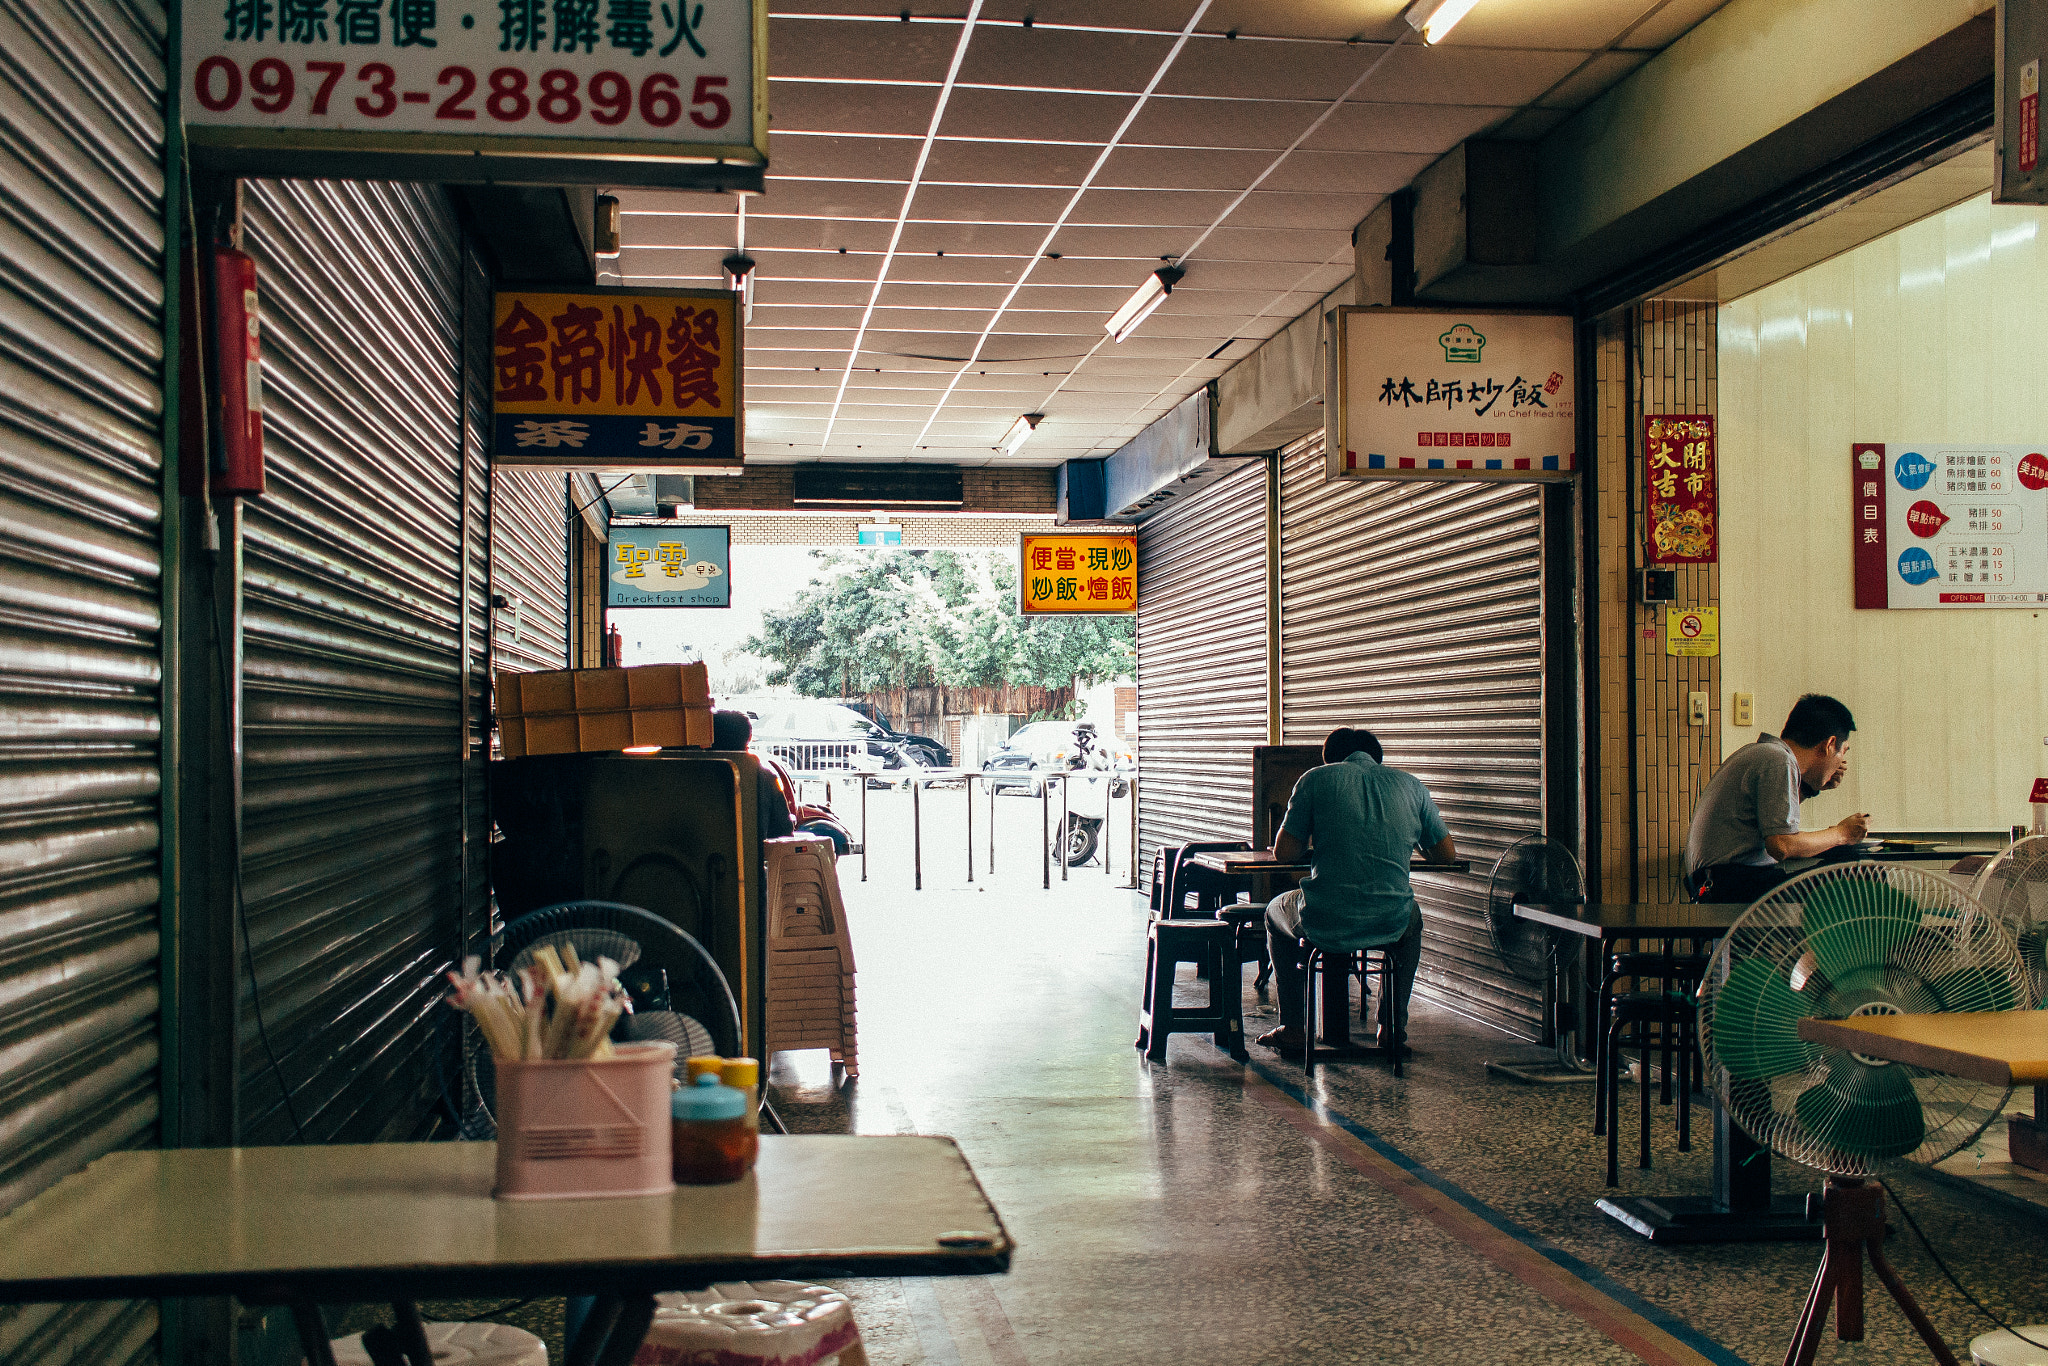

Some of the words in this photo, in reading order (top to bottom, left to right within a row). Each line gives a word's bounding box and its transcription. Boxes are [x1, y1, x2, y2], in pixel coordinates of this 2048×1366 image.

[194, 56, 732, 129] 0973-288965
[495, 300, 722, 409] 金帝快餐
[1379, 375, 1548, 417] 林師炒飯
[1493, 410, 1506, 418] Lin
[1508, 410, 1531, 418] Chef
[1533, 410, 1554, 418] fried
[1556, 410, 1573, 418] rice
[514, 420, 714, 450] 茶坊
[1419, 433, 1511, 446] 專業美式炒飯
[1946, 455, 1987, 466] 豬排燴飯
[1990, 456, 2001, 465] 60
[1652, 442, 1681, 498] 大吉
[1683, 441, 1707, 499] 開市
[1946, 468, 1987, 478] 魚排燴飯
[1990, 469, 2001, 478] 60
[1946, 481, 1987, 491] 豬肉燴飯
[1990, 482, 2001, 491] 60
[1863, 481, 1879, 544] 價目表
[1968, 508, 1988, 518] 豬排
[1991, 509, 2002, 518] 50
[1968, 521, 1988, 531] 魚排
[1991, 522, 2002, 531] 50
[1992, 548, 2003, 556] 20
[1993, 561, 2003, 569] 15
[1993, 573, 2003, 582] 15
[617, 593, 684, 604] Breakfast
[690, 593, 720, 605] shop
